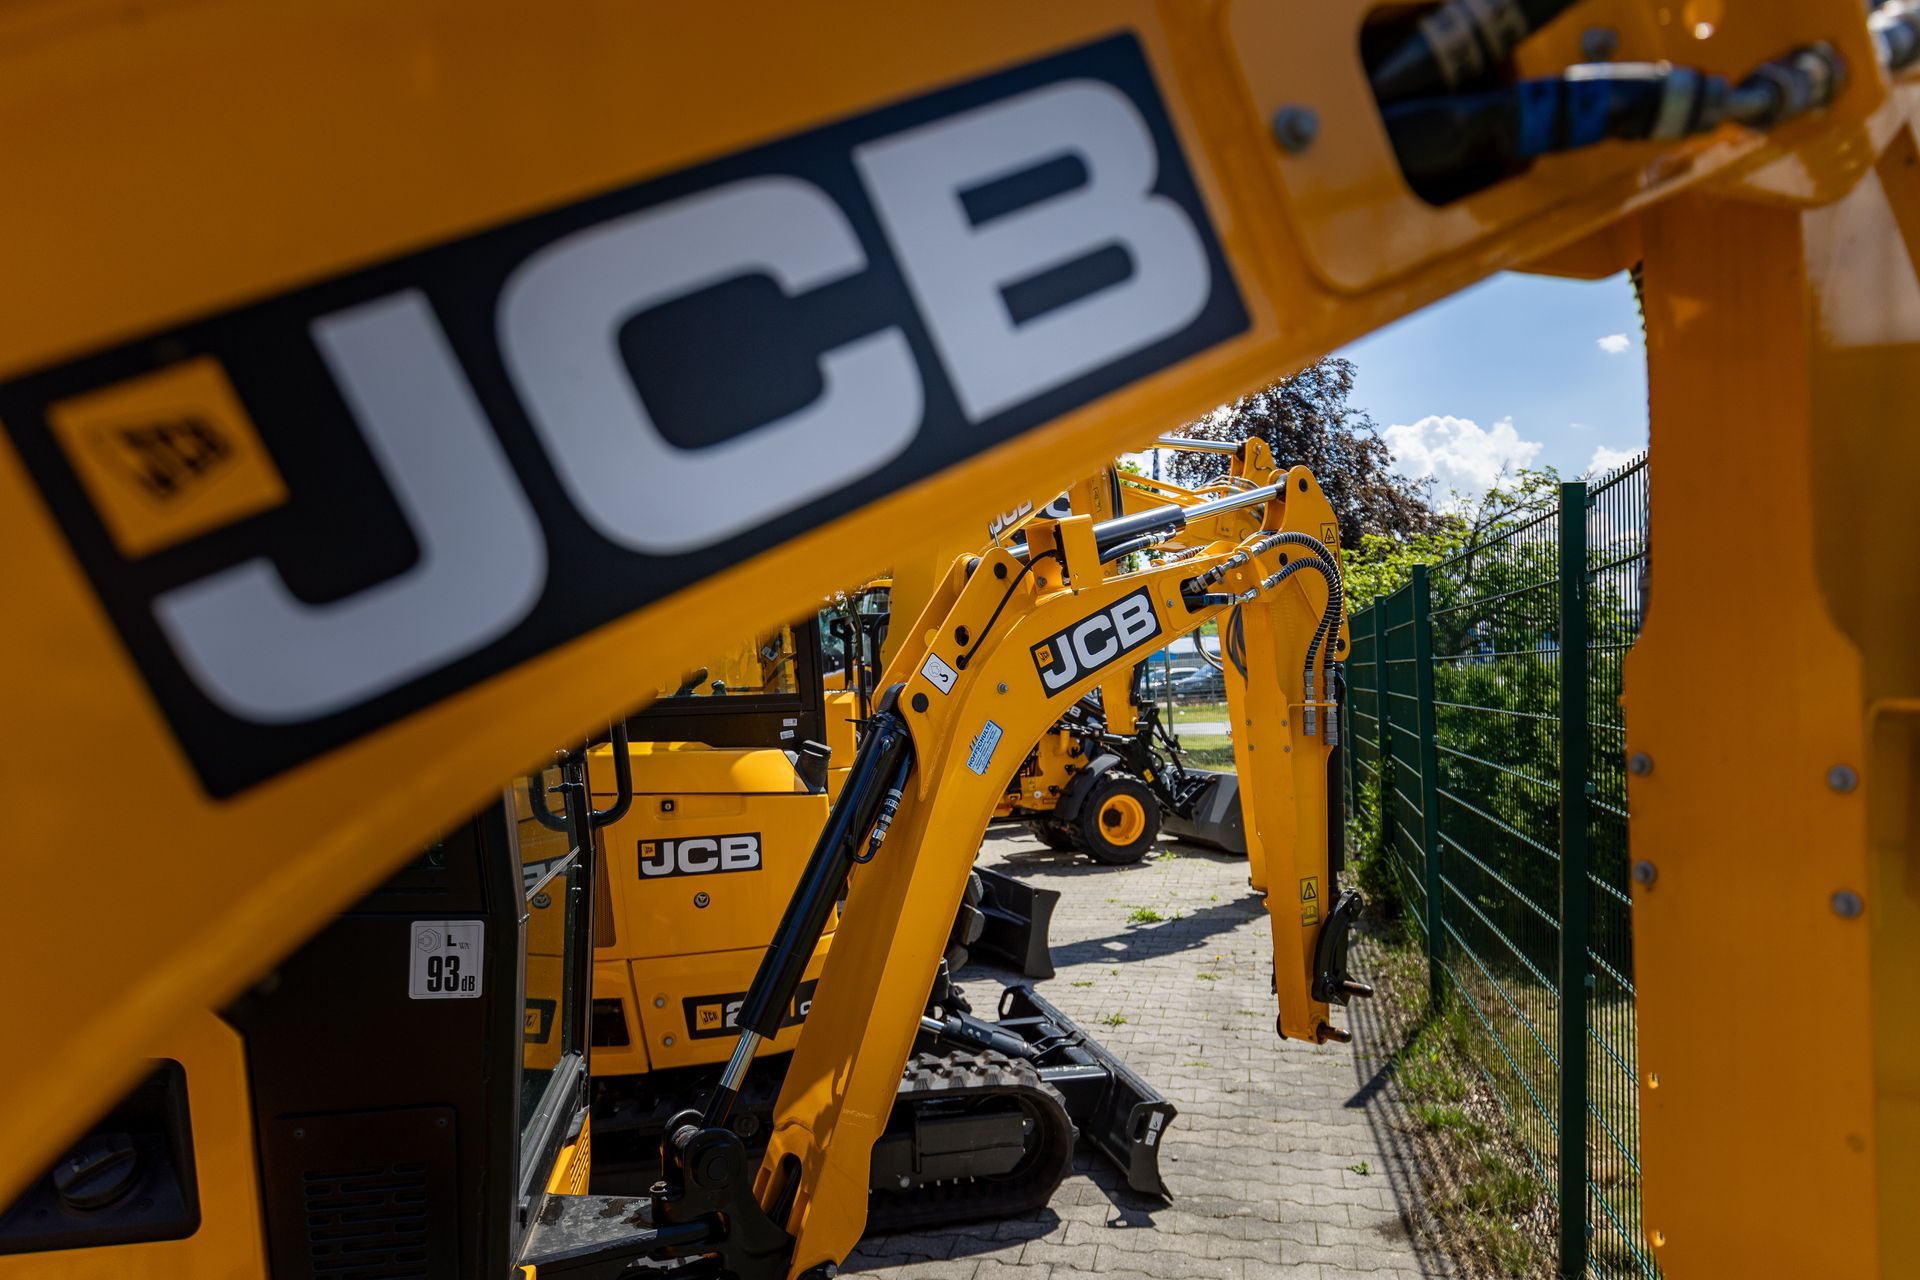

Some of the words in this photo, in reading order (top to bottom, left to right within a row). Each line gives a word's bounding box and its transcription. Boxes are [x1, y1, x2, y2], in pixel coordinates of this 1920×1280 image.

[154, 77, 1212, 725] JCB
[1043, 594, 1156, 689] JCB
[641, 836, 760, 876] JCB
[447, 934, 457, 947] L
[427, 955, 461, 992] 93
[461, 975, 476, 992] dB
